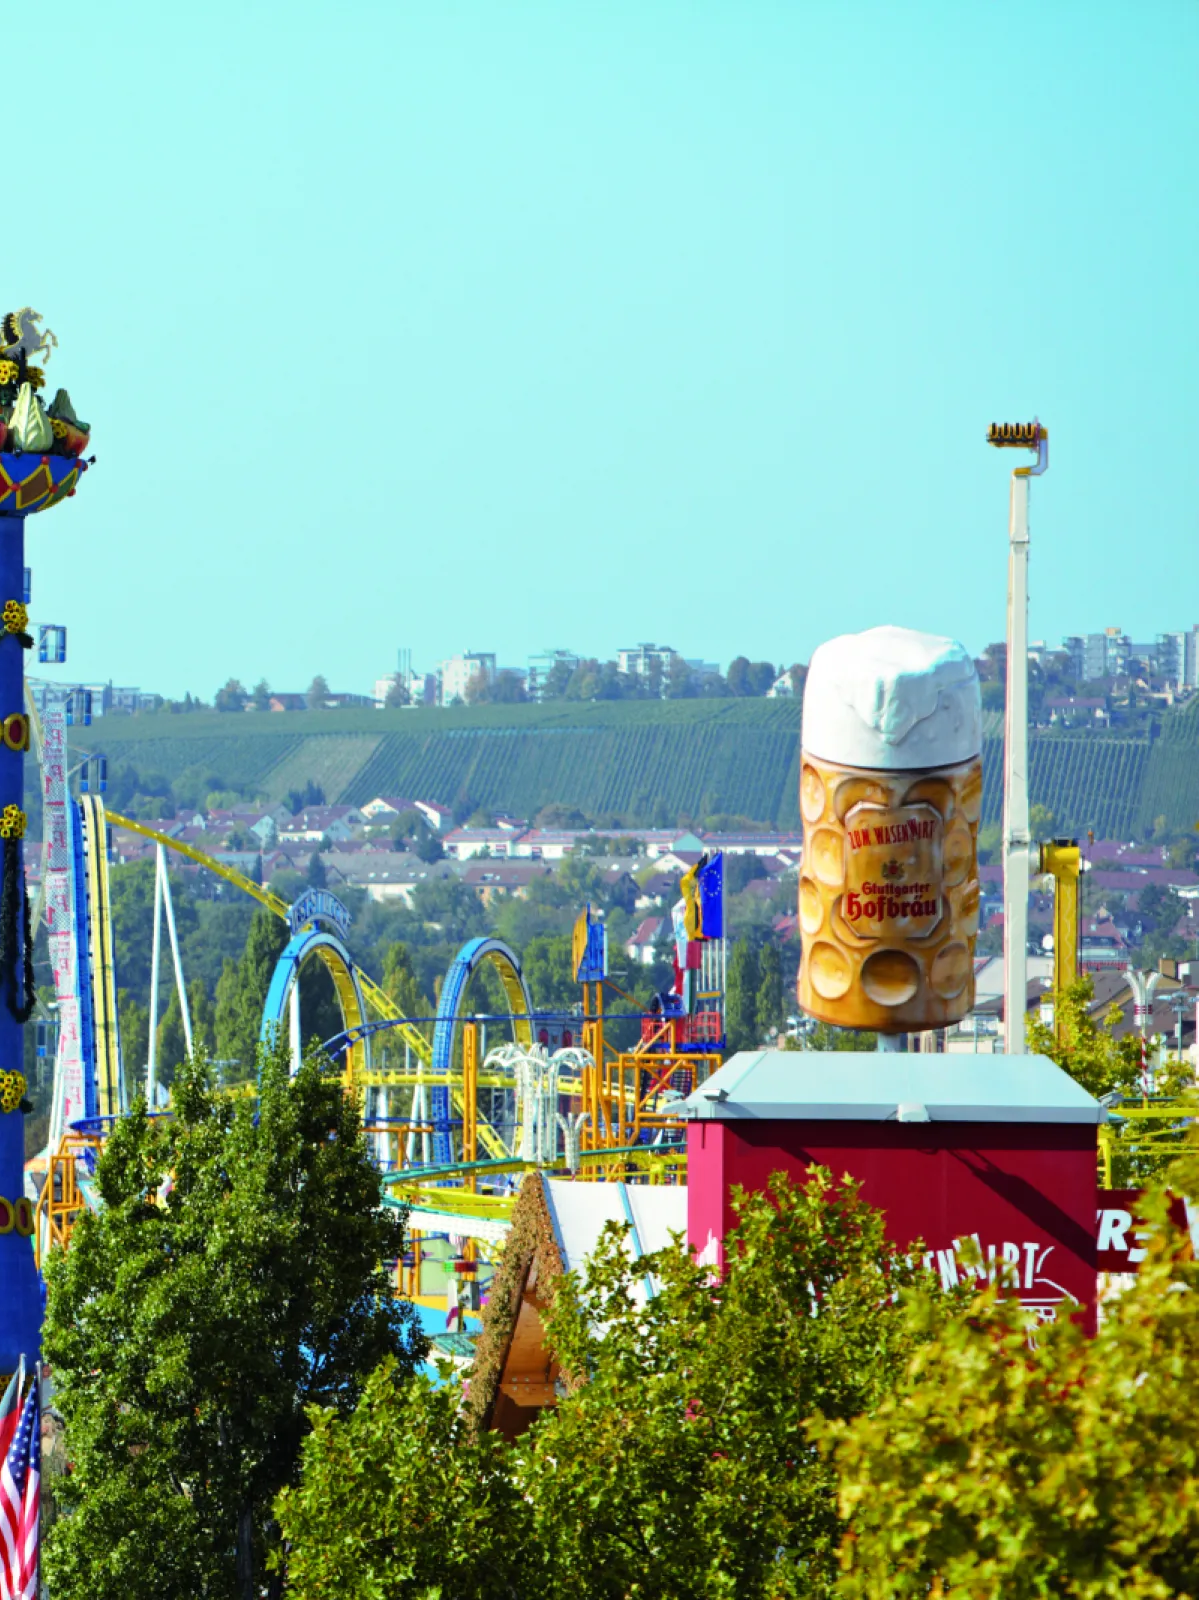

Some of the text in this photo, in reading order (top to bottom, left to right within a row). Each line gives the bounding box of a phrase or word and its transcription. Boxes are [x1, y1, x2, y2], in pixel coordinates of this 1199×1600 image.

[848, 828, 871, 849] ZUM
[862, 881, 930, 898] Stuttgarter
[847, 892, 937, 922] Hofbräu
